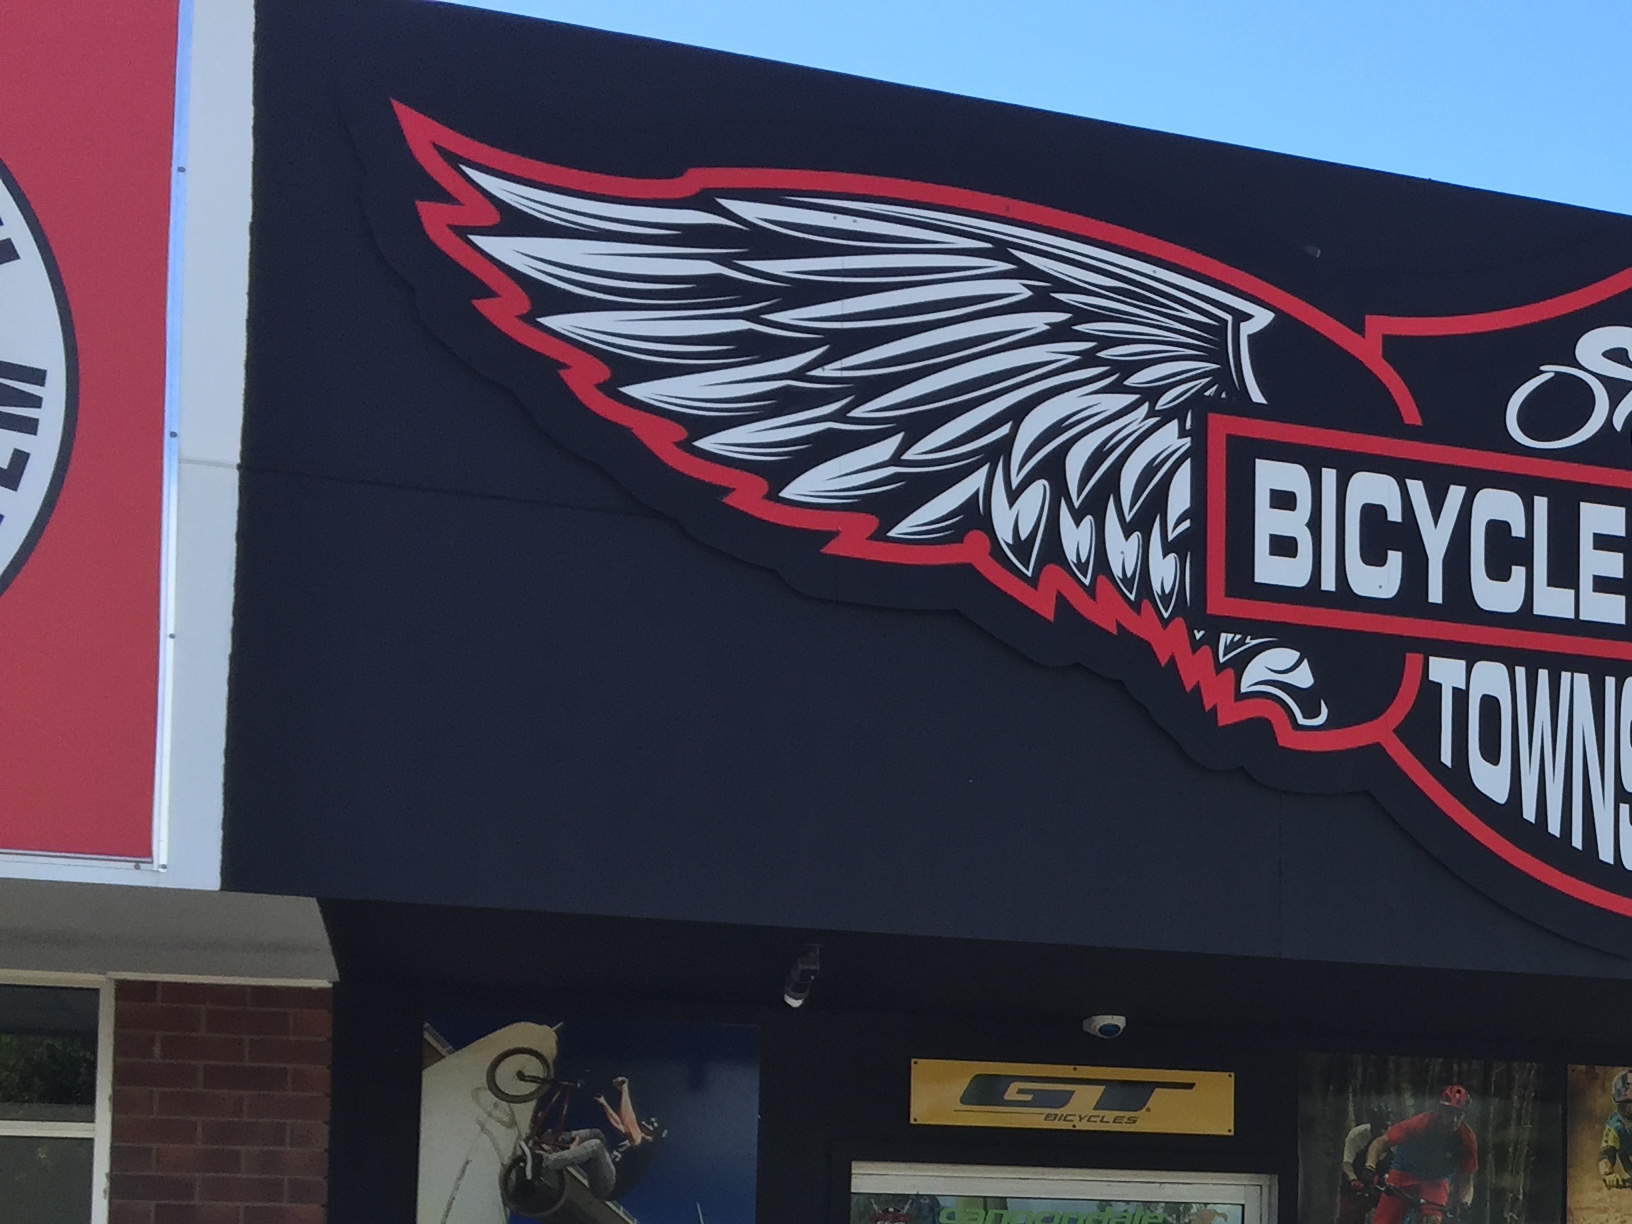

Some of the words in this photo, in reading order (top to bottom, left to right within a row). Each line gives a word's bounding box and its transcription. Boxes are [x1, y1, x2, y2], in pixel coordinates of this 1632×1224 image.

[1254, 458, 1626, 625] BICYCLE
[960, 1073, 1196, 1112] GT
[1043, 1112, 1141, 1125] BICYCLES
